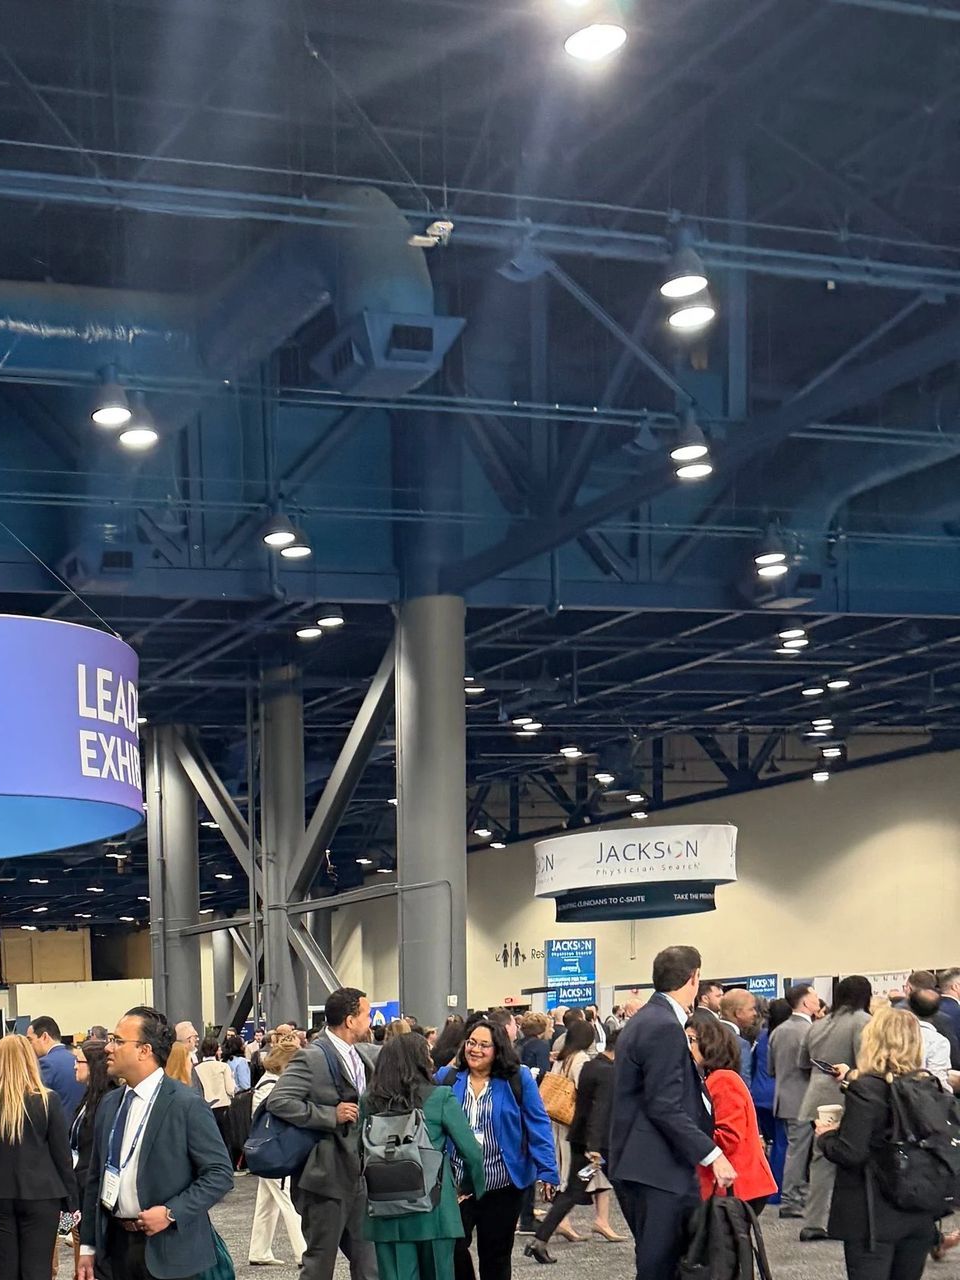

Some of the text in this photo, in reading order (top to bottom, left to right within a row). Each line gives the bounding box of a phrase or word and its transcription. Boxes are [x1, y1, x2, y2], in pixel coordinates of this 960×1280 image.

[78, 663, 140, 739] LEAD
[596, 839, 698, 864] JACKSON
[596, 866, 654, 877] Physician
[619, 895, 645, 904] C-SUITE
[673, 893, 689, 901] TAKE
[551, 940, 592, 951] JACKSON
[559, 987, 592, 998] JACKSON
